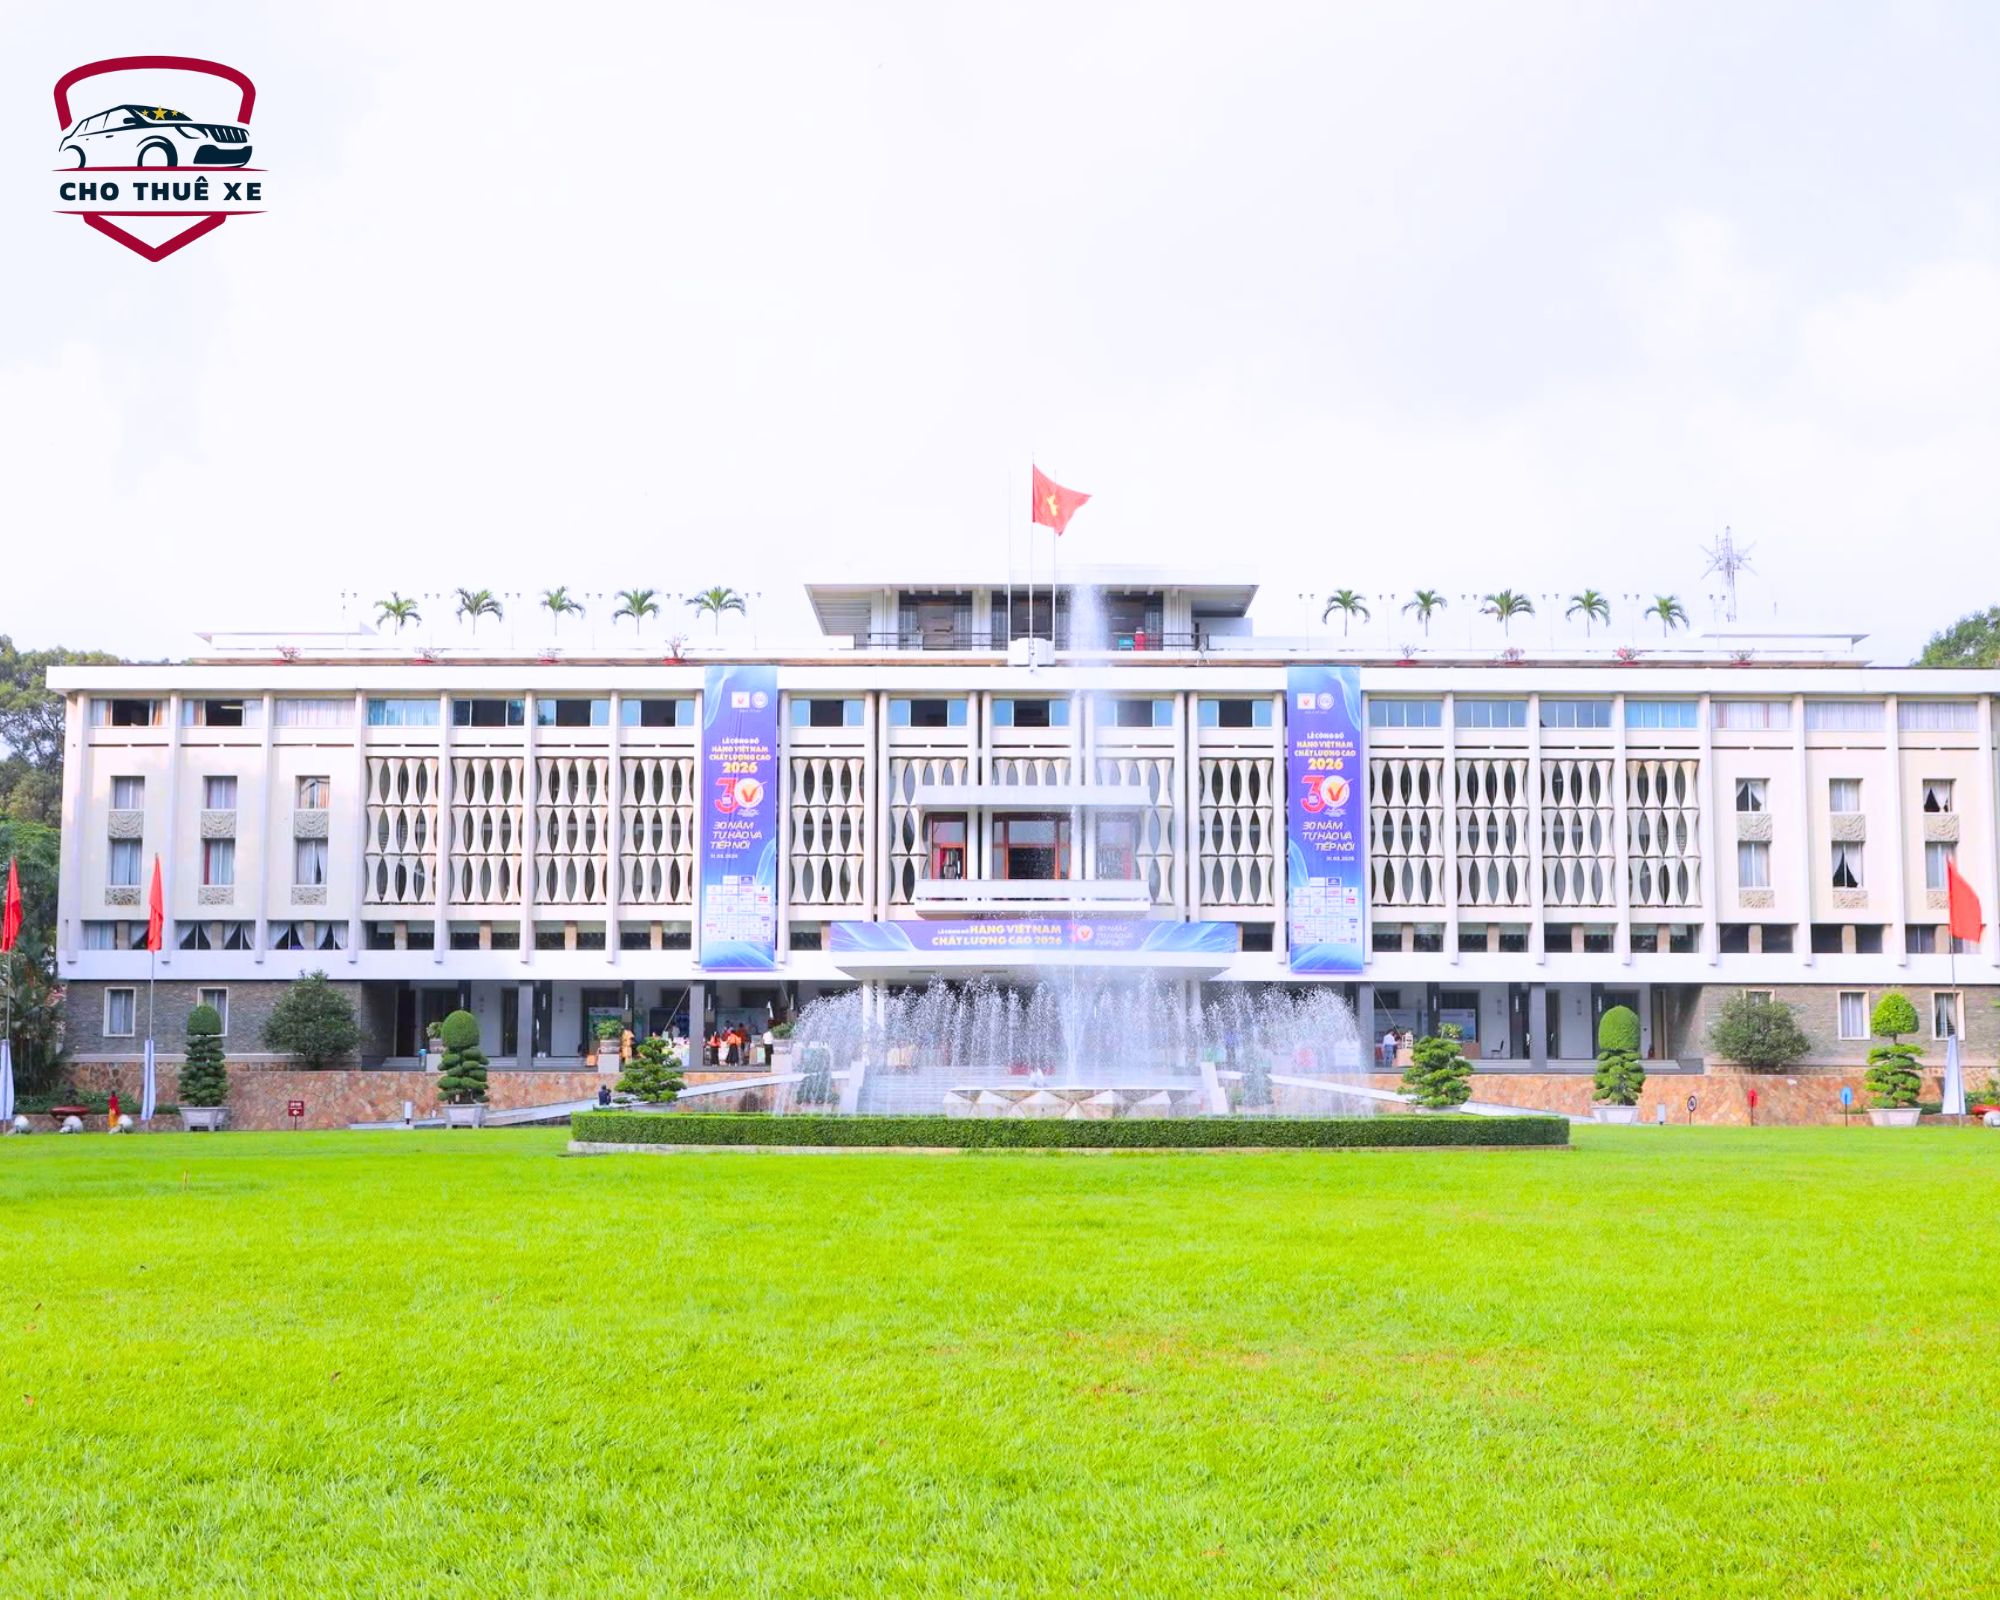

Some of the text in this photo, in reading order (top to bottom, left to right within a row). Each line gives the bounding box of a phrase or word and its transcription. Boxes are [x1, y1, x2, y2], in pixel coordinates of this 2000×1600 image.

[722, 761, 758, 774] 2026
[1307, 757, 1344, 770] 2026
[1008, 936, 1032, 945] CAO
[1034, 936, 1062, 945] 2026
